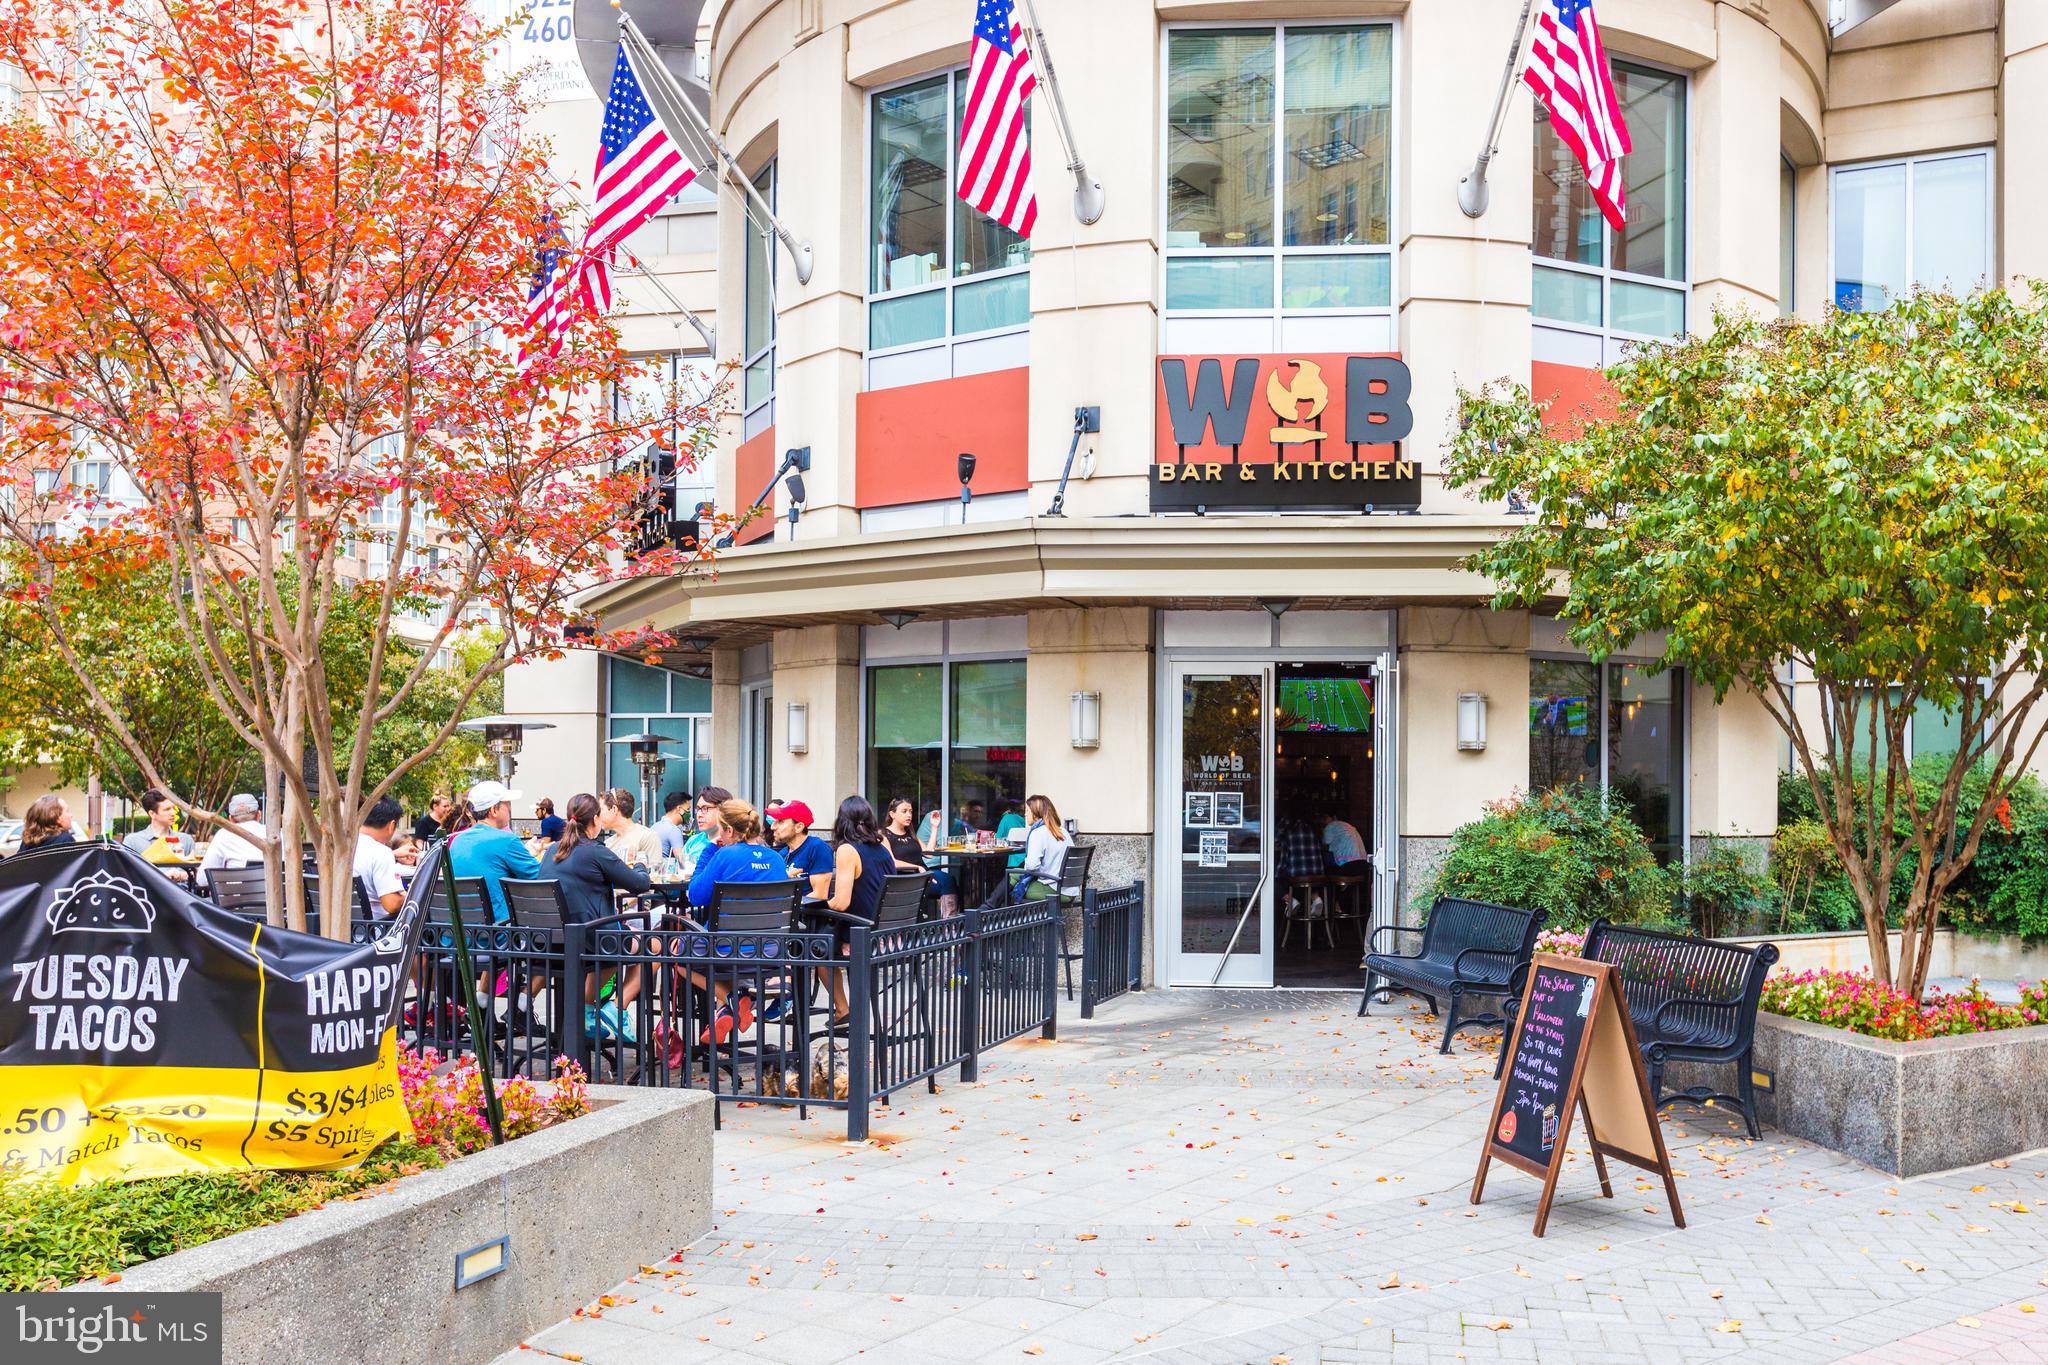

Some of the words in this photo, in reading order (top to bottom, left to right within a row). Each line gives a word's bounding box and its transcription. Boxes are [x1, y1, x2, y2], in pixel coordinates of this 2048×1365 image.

[524, 16, 571, 42] 460
[1159, 463, 1222, 482] BAR
[1239, 462, 1256, 481] &
[1273, 460, 1414, 481] KITCHEN
[13, 955, 190, 1002] TUESDAY
[29, 1005, 157, 1051] TACOS
[310, 1013, 389, 1053] MON-F
[0, 1107, 66, 1134] .50
[265, 1118, 311, 1141] $5
[315, 1124, 363, 1148] Spir
[38, 1134, 120, 1168] Match
[128, 1124, 202, 1151] Tacos
